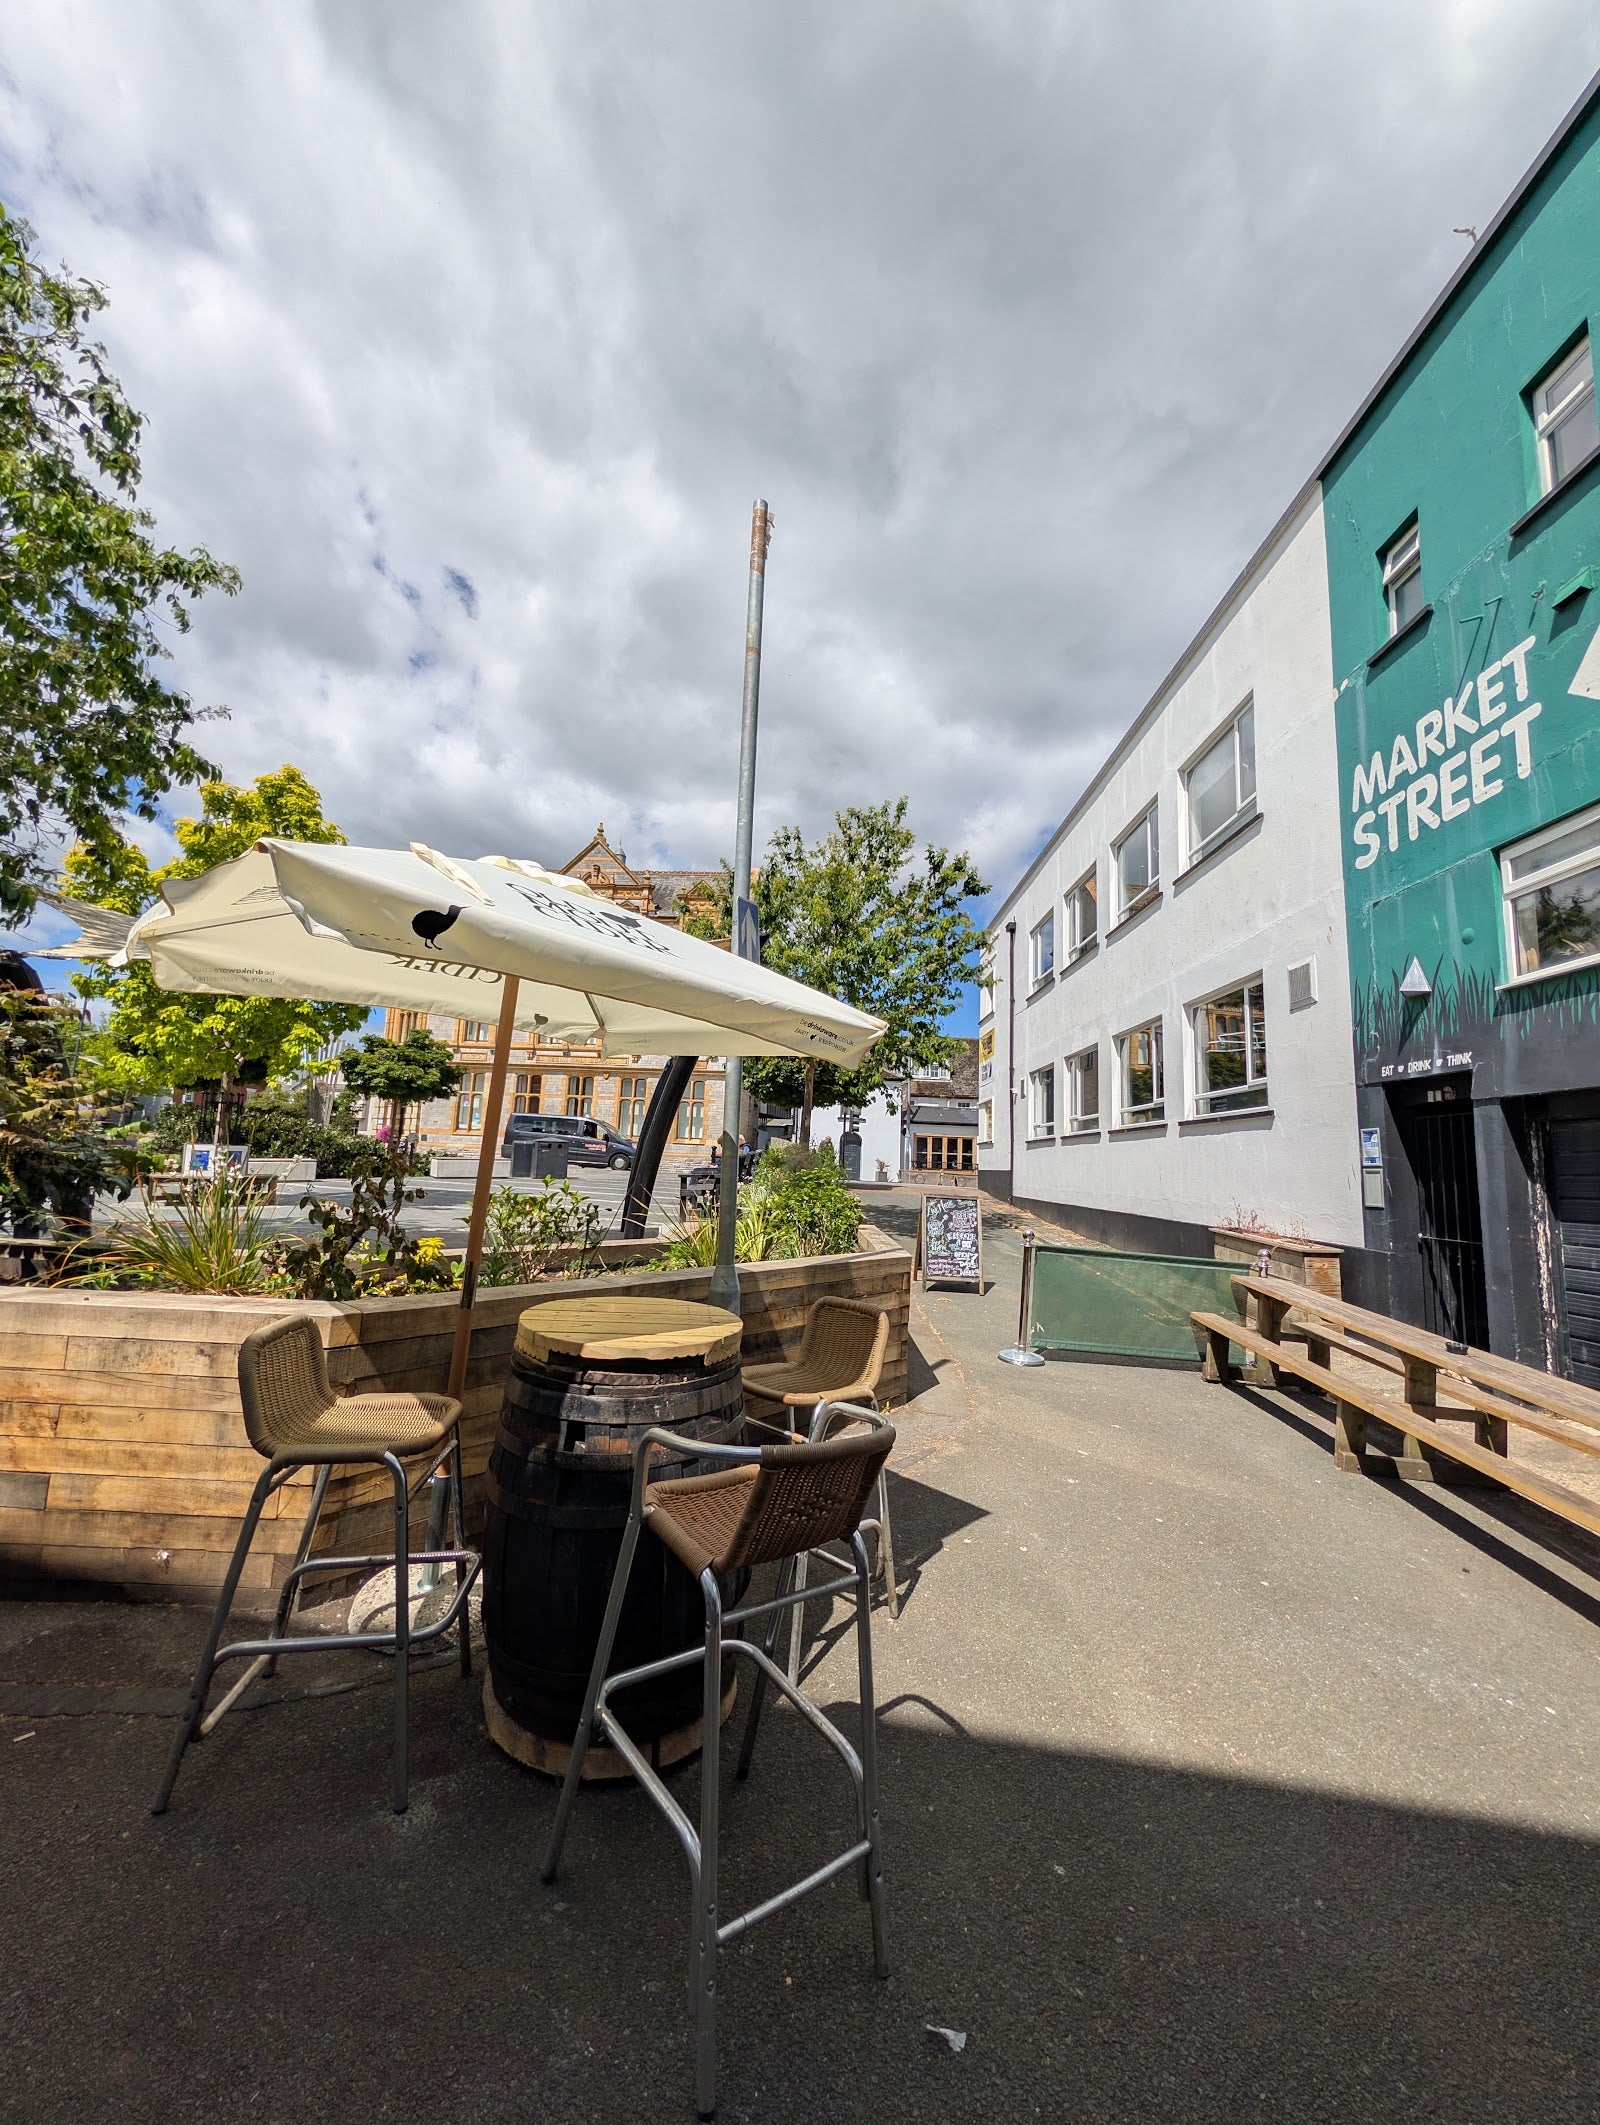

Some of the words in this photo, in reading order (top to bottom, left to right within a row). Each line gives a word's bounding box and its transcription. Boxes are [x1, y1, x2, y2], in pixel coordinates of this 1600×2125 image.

[1352, 635, 1536, 813] MARKET
[1353, 702, 1542, 869] STREET
[505, 882, 597, 916] OLD
[519, 892, 656, 942] MOUT
[533, 905, 687, 960] CIDER
[1381, 1065, 1395, 1077] EAT
[1407, 1059, 1432, 1074] DRINK
[1446, 1052, 1473, 1067] THINK
